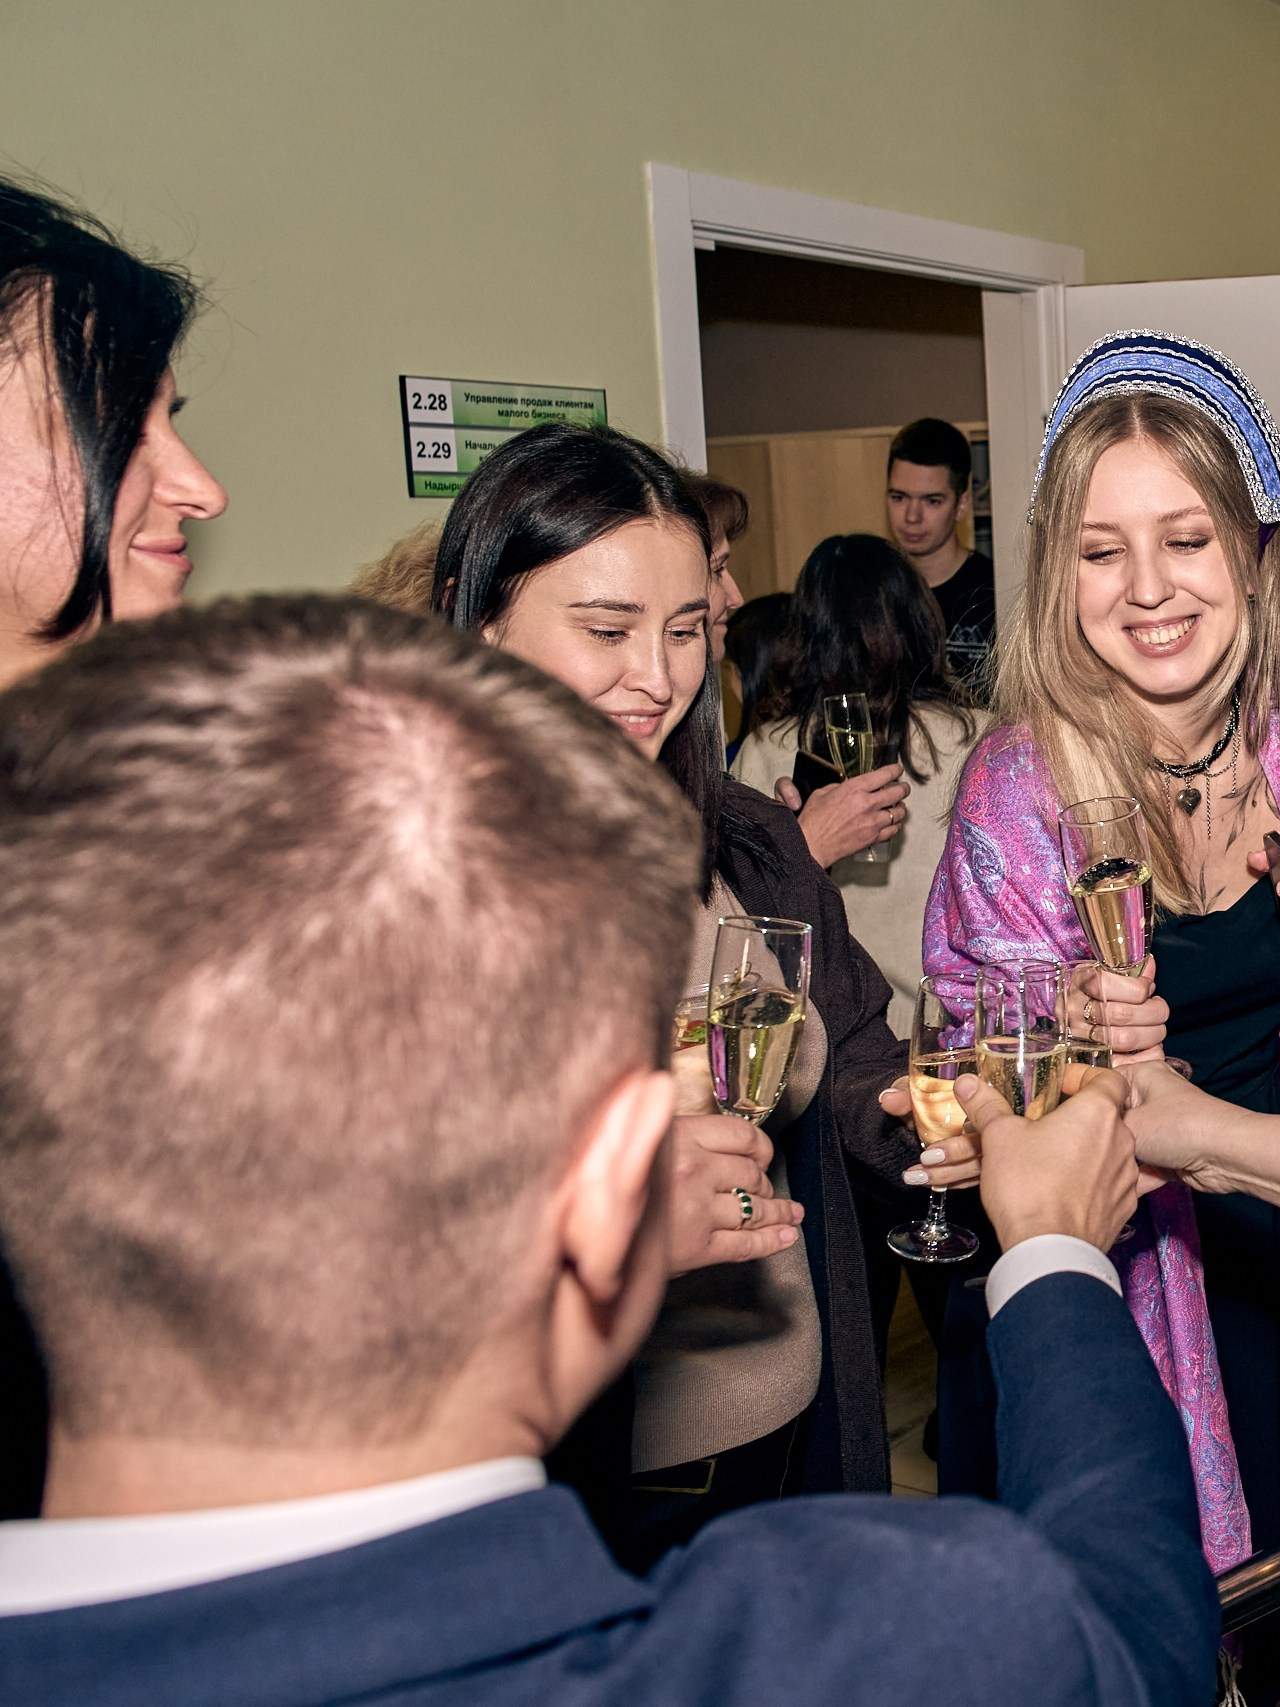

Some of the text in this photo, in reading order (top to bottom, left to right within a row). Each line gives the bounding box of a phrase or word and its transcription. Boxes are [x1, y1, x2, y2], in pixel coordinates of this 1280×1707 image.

[412, 392, 448, 411] 2.28
[464, 392, 594, 409] Управление продаж клиентам
[498, 409, 566, 420] малого бизнеса
[416, 441, 451, 459] 2.29
